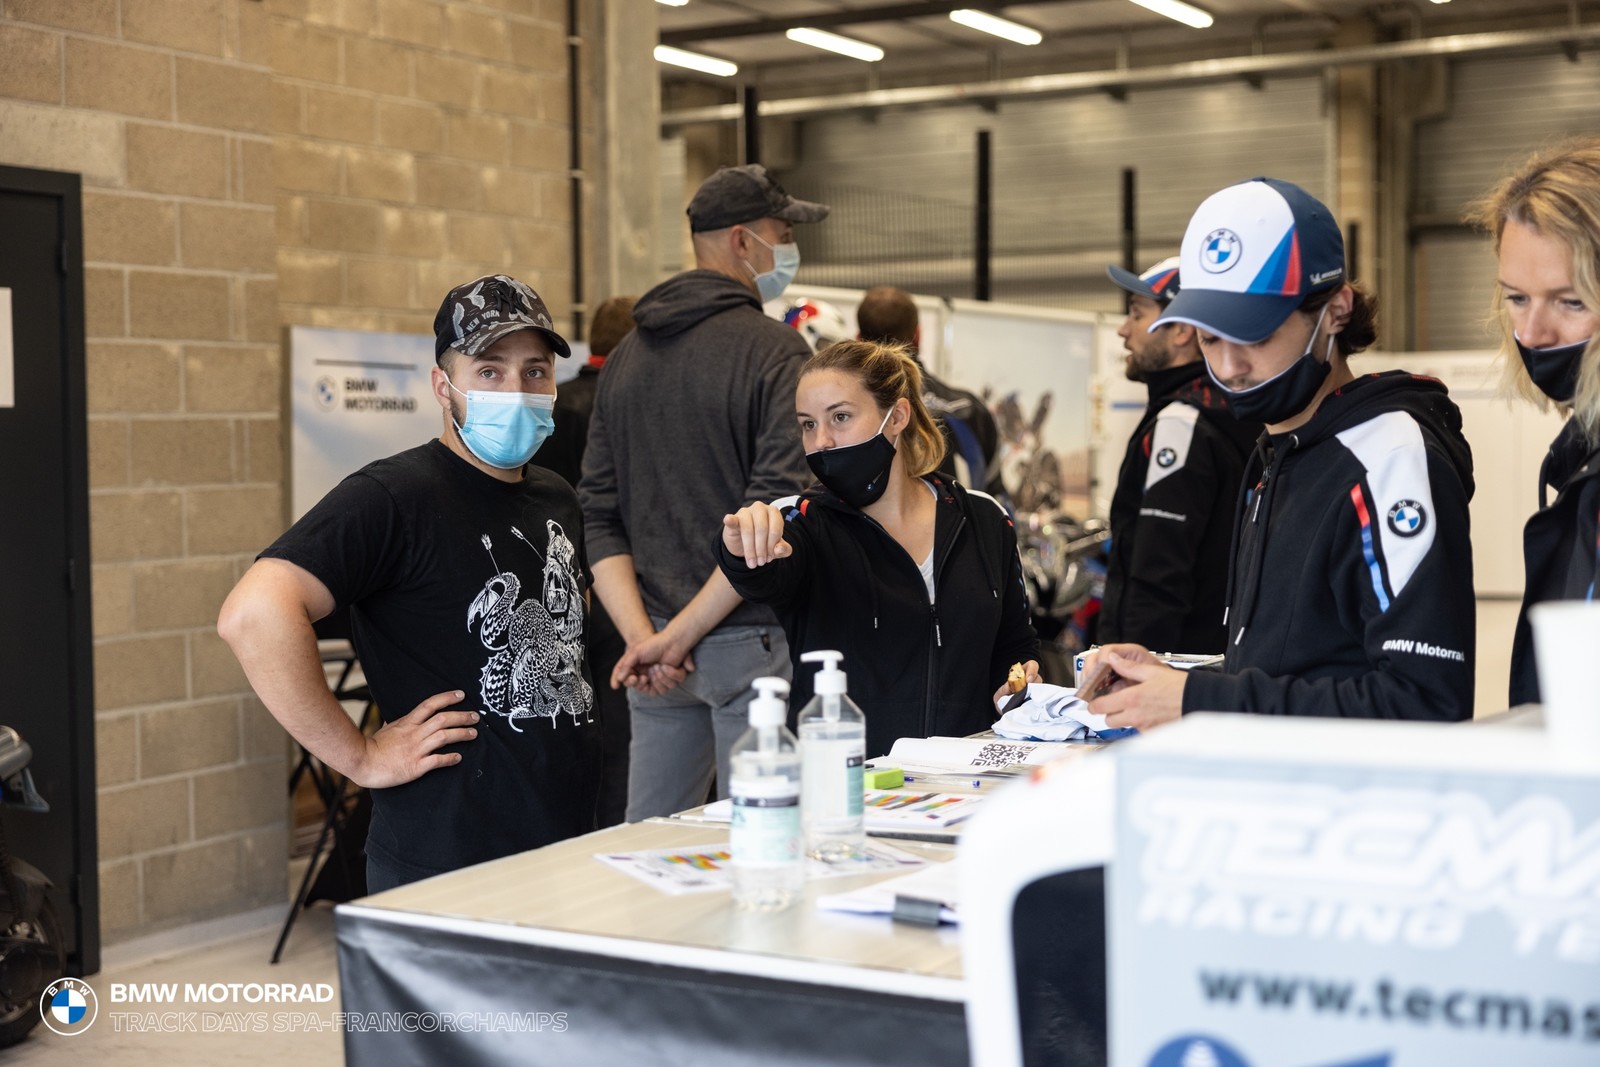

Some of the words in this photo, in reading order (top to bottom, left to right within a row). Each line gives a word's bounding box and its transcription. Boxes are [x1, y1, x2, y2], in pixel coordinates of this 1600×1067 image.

[1205, 230, 1237, 244] BMW
[465, 317, 480, 333] NEW
[481, 309, 500, 320] YORK
[344, 379, 379, 393] BMW
[344, 397, 418, 413] MOTORRAD
[1388, 499, 1421, 518] BMW
[1382, 639, 1415, 654] BMW
[1415, 641, 1465, 662] Motorra
[1138, 888, 1467, 951] RACING
